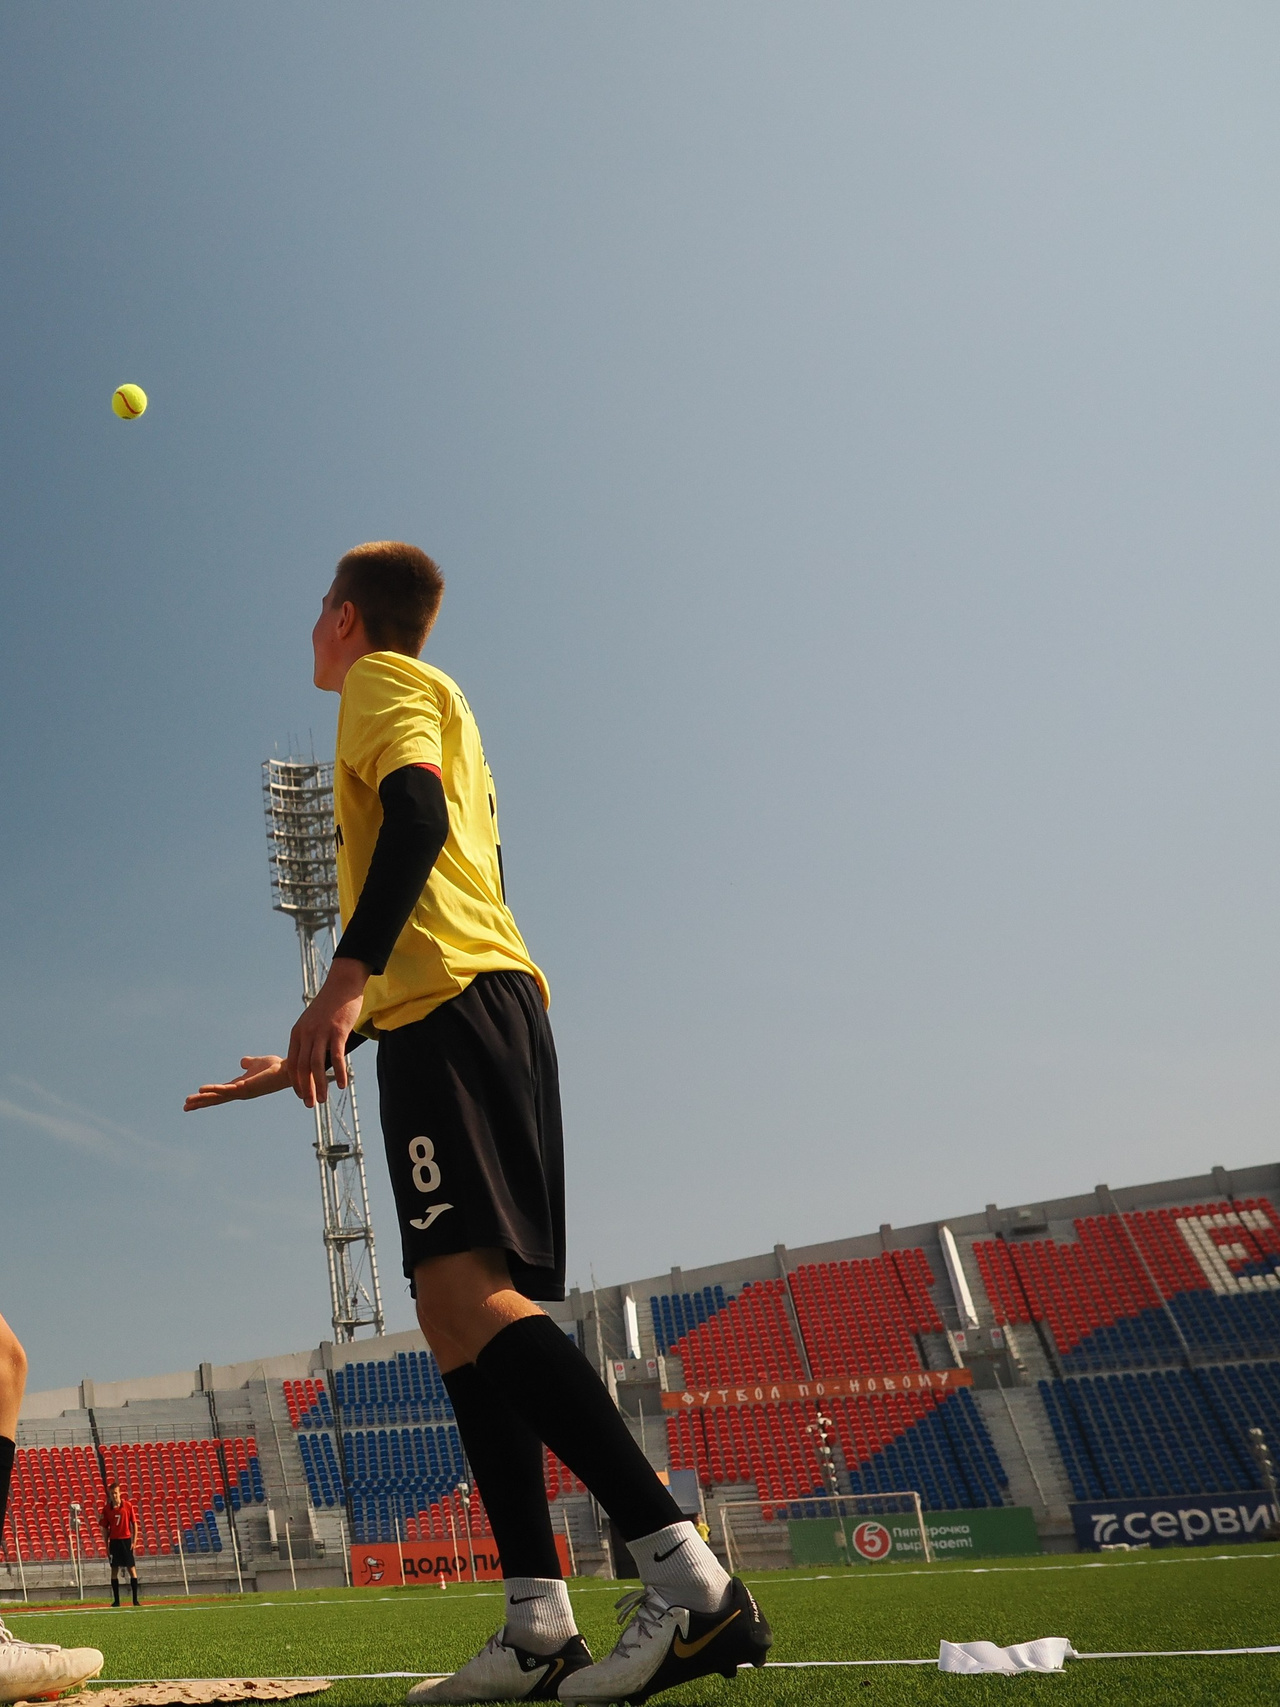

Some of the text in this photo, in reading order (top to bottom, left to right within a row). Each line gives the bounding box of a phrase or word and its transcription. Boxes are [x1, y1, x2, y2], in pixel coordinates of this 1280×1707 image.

[408, 1135, 441, 1193] 8
[681, 1385, 781, 1405] ФУТБОЛ
[114, 1514, 121, 1526] 7
[896, 1537, 973, 1553] вырчает!
